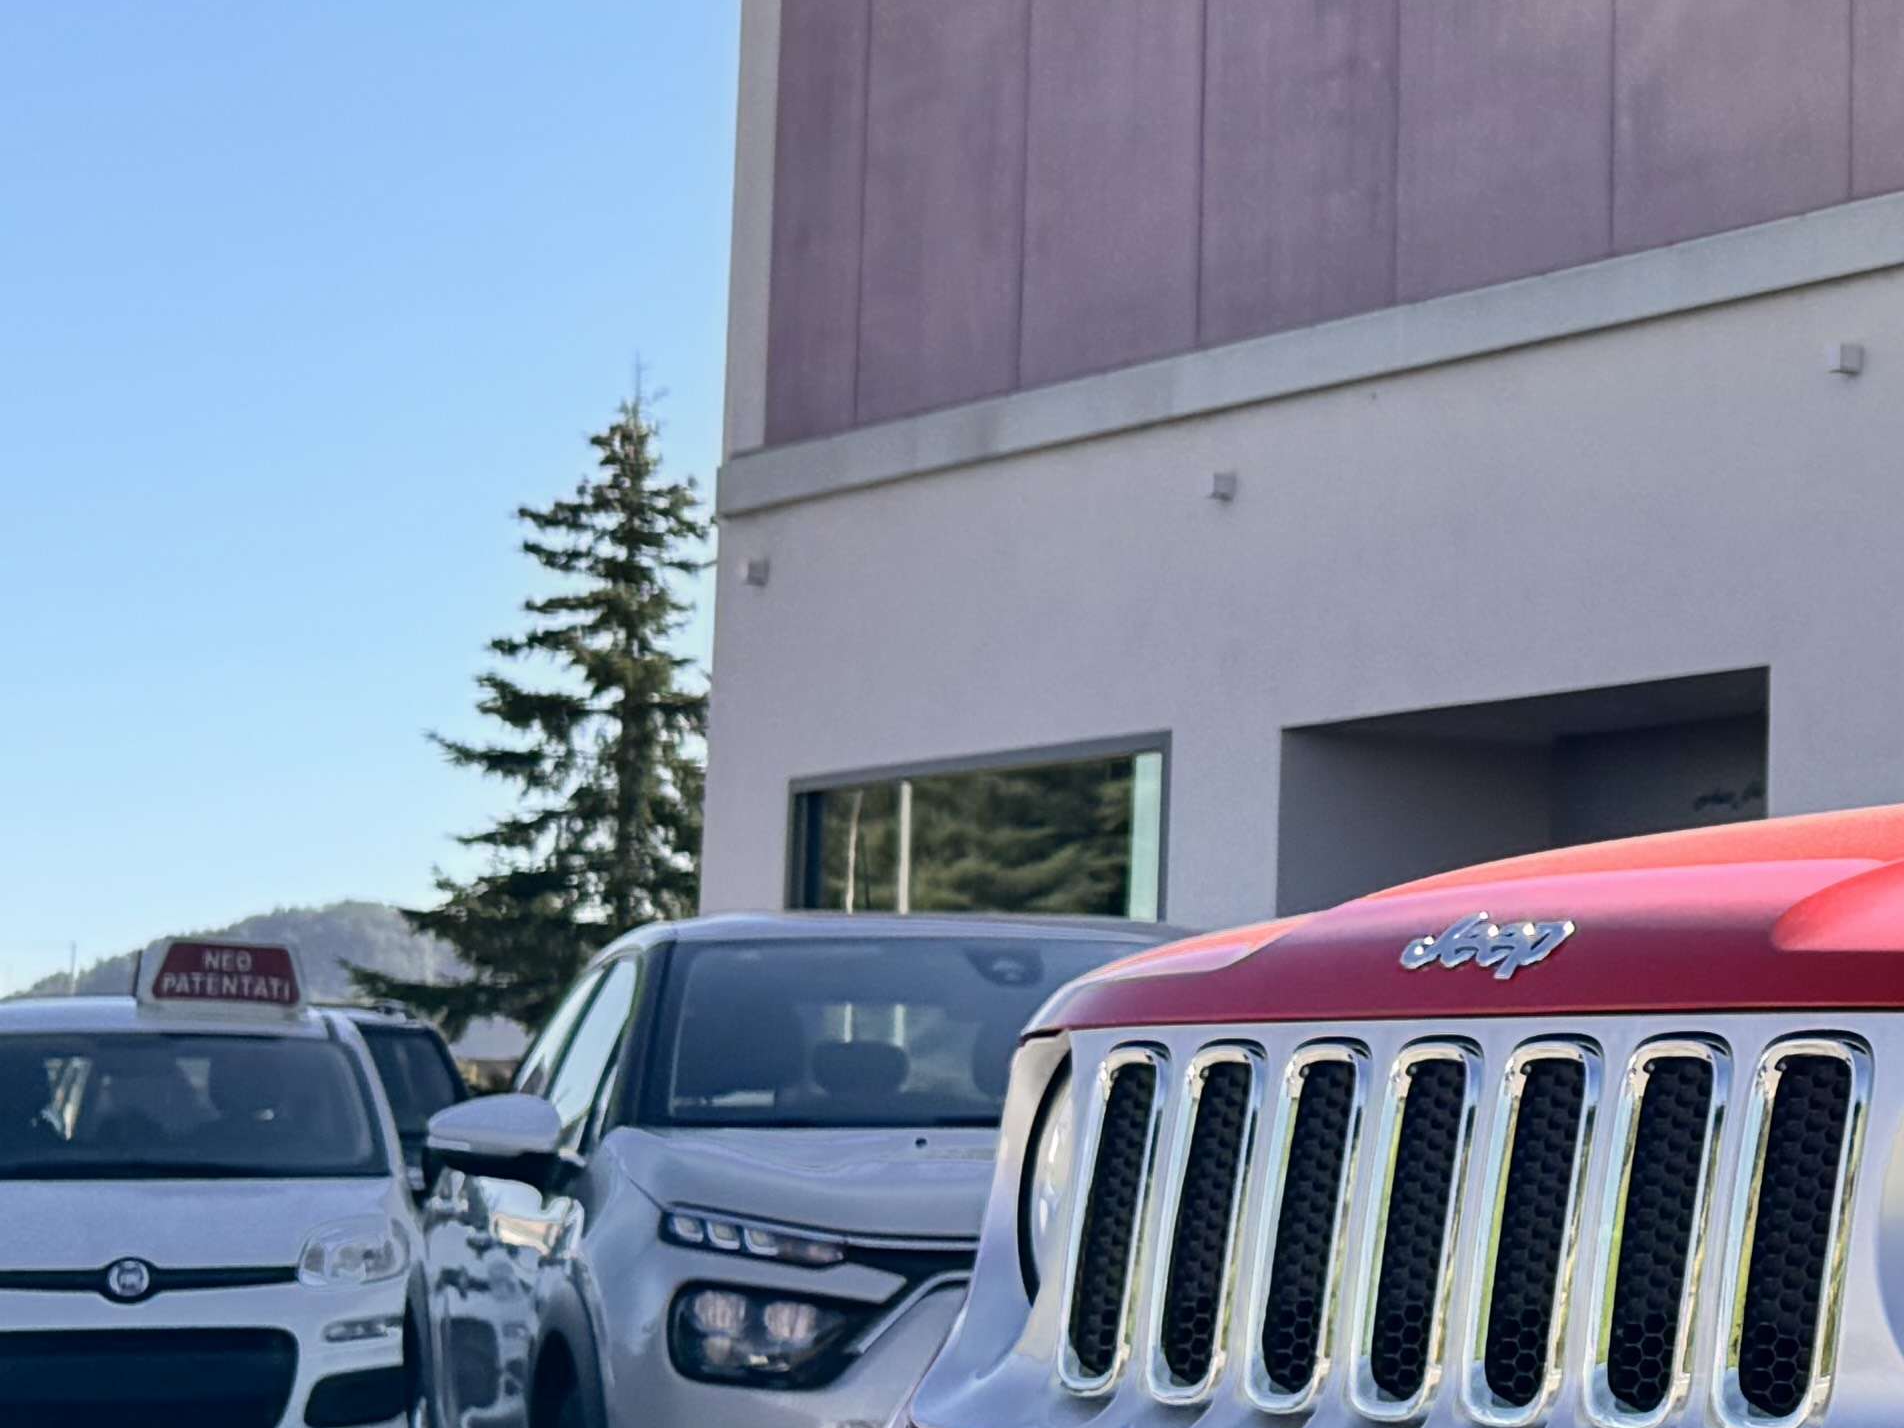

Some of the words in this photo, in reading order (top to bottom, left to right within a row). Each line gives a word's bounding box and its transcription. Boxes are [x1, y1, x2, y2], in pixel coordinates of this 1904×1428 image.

[1399, 911, 1575, 980] Jeep
[204, 950, 252, 972] NEO
[163, 973, 290, 1000] PATENTATI
